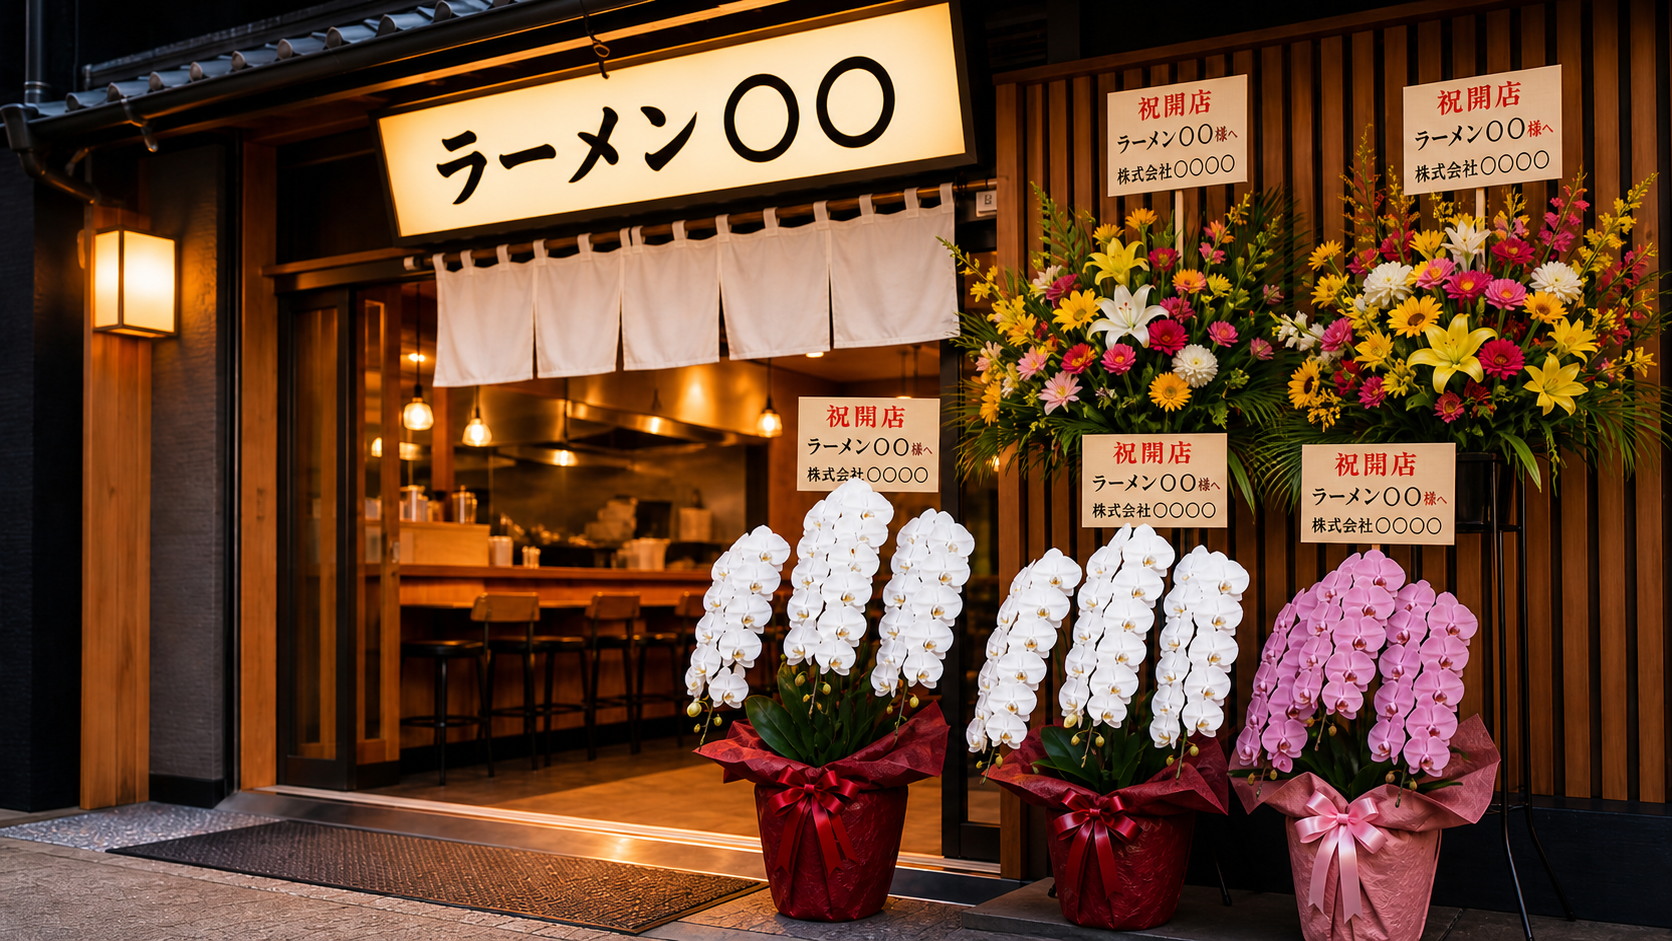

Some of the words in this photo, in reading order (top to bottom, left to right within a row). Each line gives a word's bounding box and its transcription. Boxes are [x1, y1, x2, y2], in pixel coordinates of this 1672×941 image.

[1138, 89, 1212, 121] 祝開店
[1437, 80, 1521, 115] 祝開店
[826, 404, 905, 428] 祝開店
[1113, 441, 1192, 464] 祝開店
[1334, 452, 1417, 477] 祝開店
